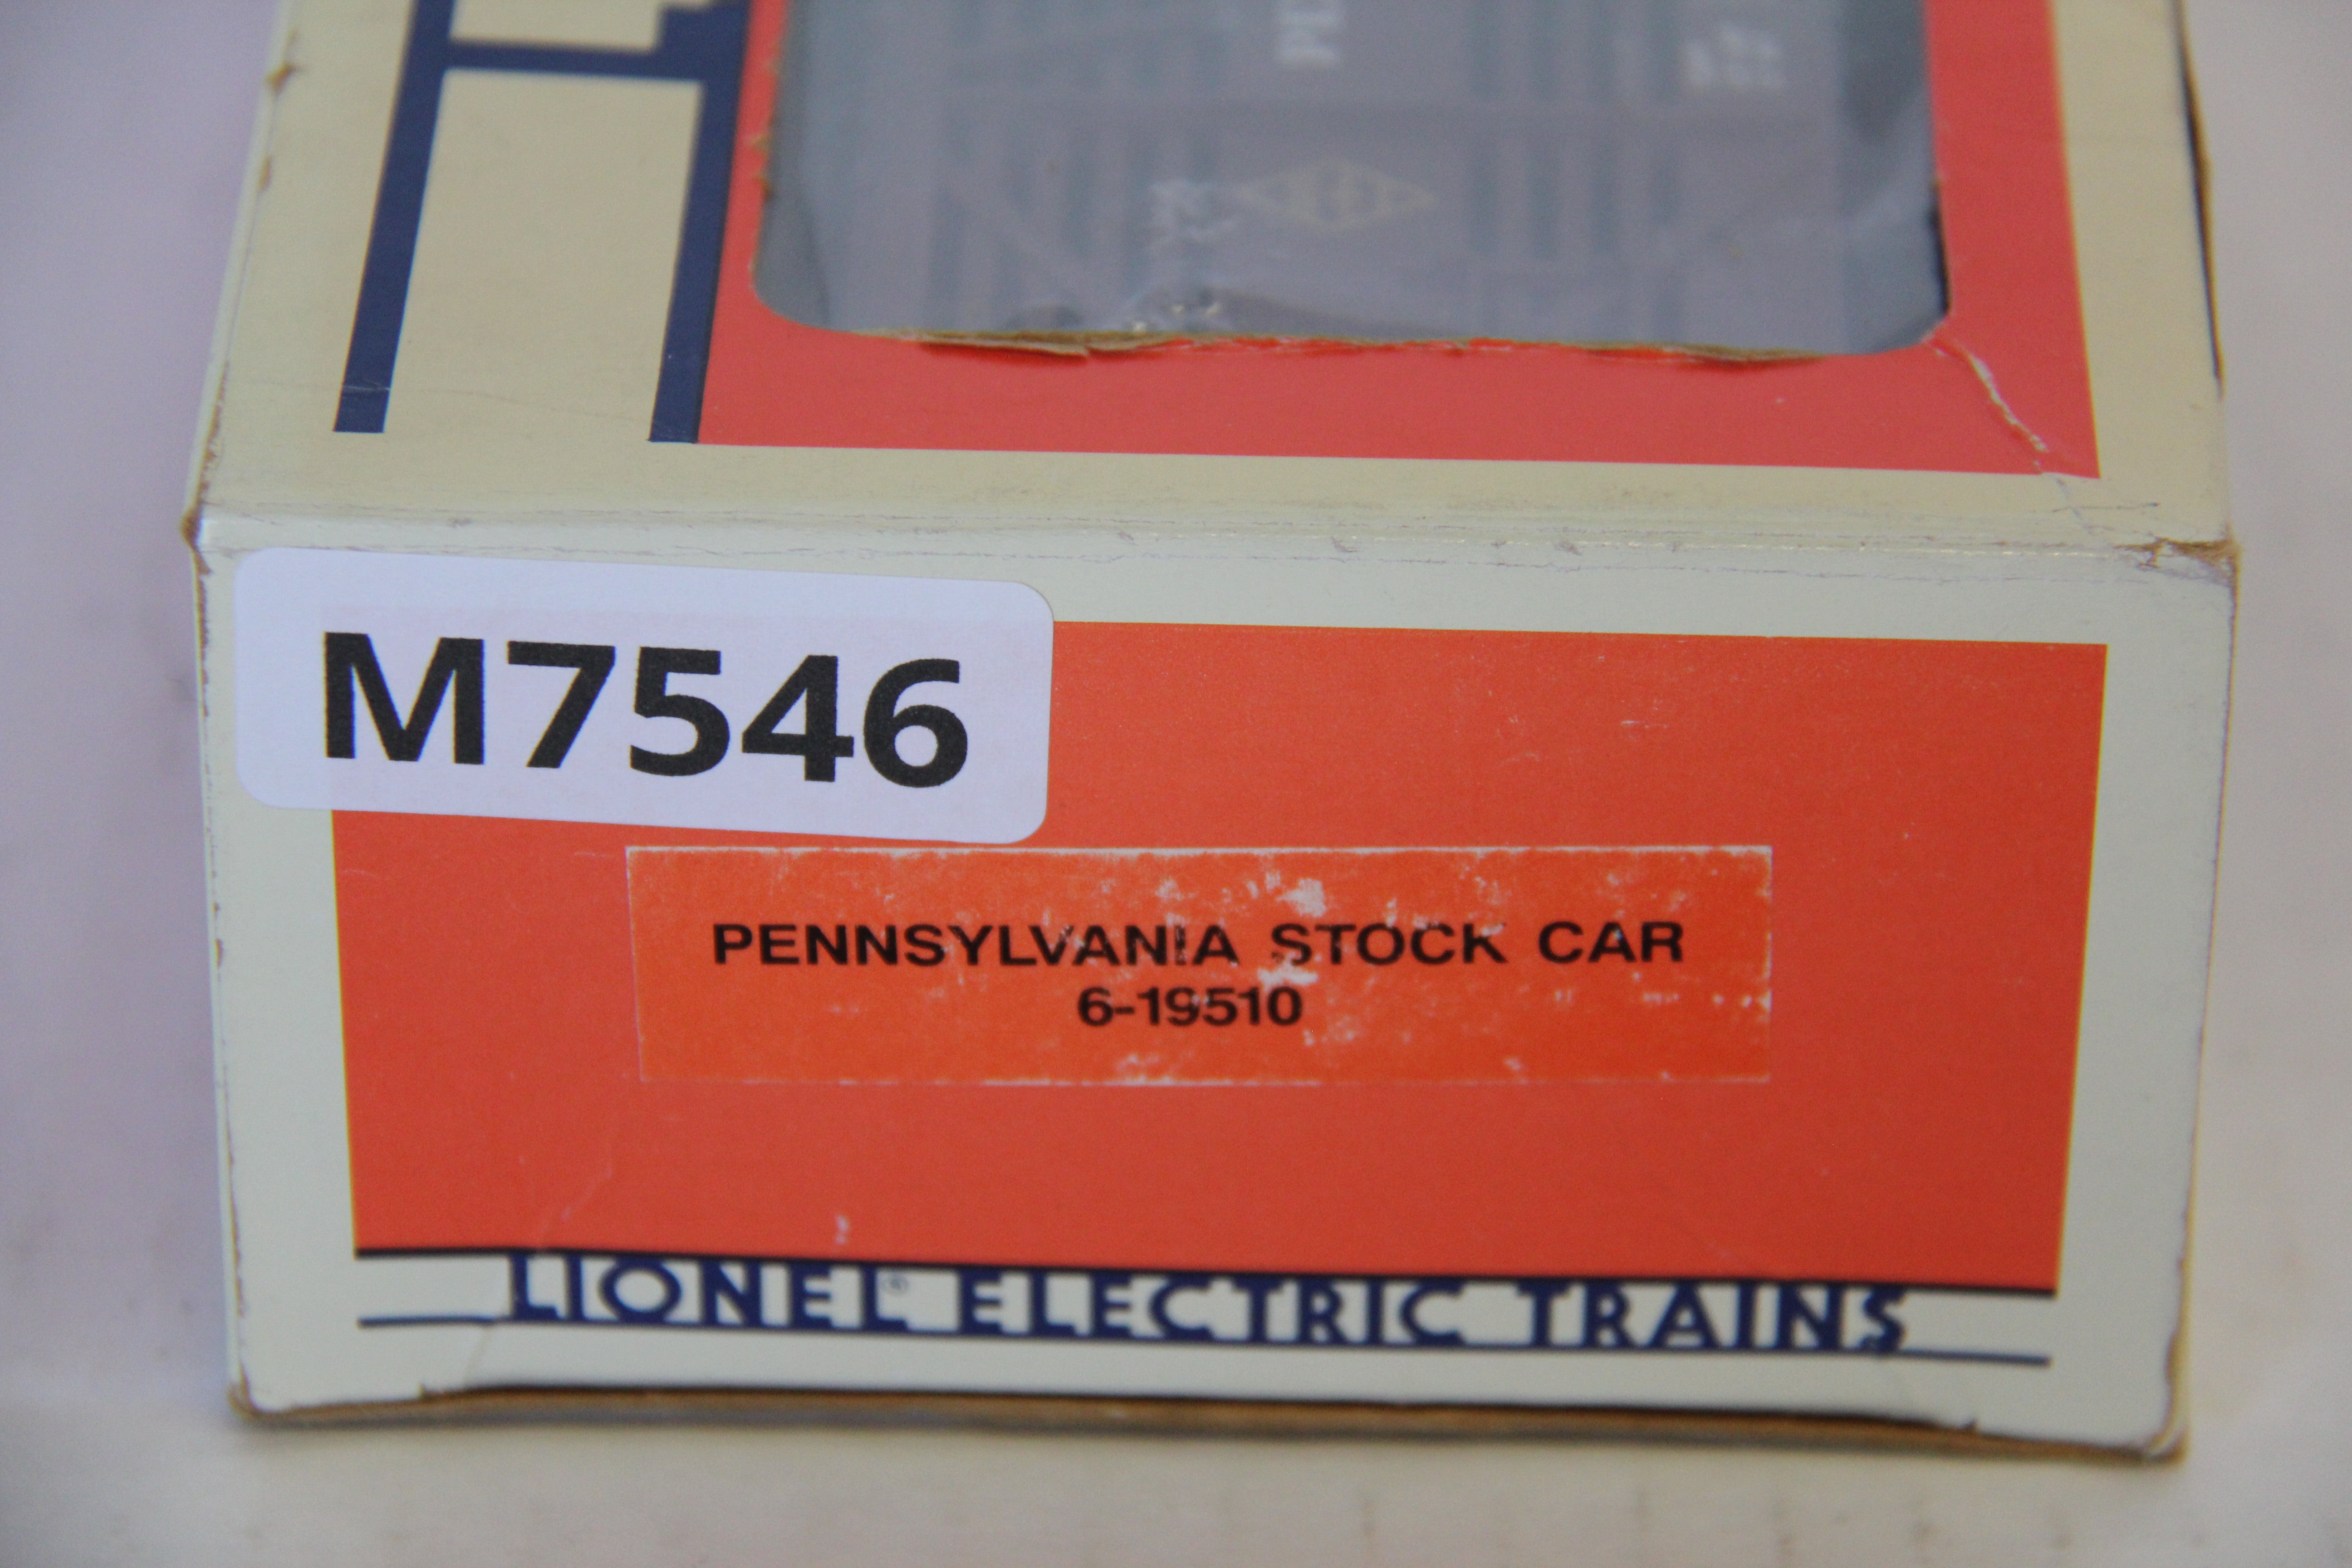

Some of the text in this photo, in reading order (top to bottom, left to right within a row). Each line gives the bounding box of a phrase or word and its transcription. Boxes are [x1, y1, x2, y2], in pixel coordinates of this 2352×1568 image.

[323, 632, 969, 788] M7546
[712, 921, 1684, 966] PENNSYLVANIA STOCK CAR
[1077, 985, 1303, 1027] 6-19510
[508, 1250, 1905, 1353] LIONEL ELECTRIC TRAINS
